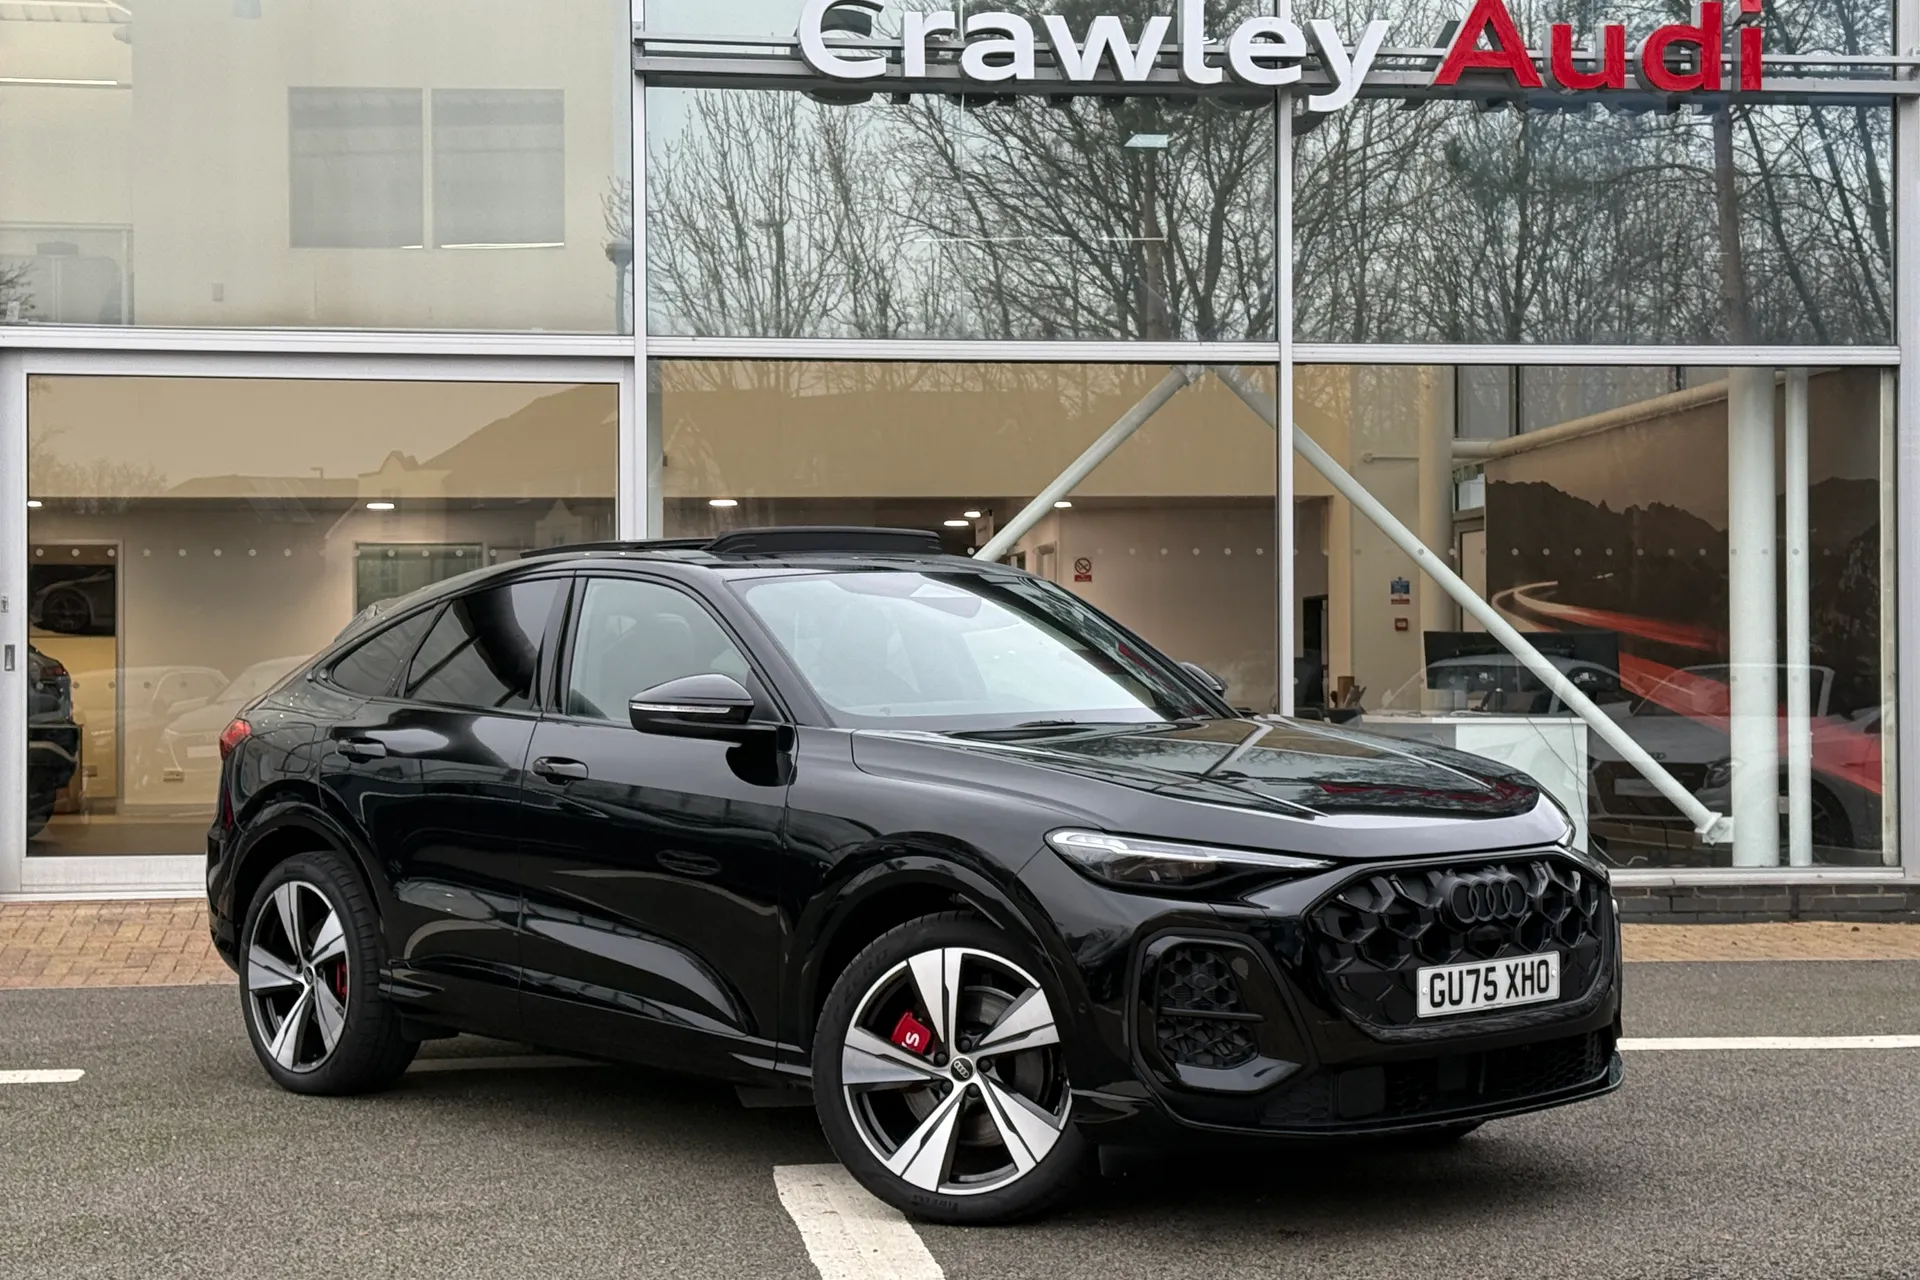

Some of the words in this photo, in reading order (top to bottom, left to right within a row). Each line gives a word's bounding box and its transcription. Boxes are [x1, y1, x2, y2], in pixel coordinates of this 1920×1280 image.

[796, 0, 1390, 111] Crawley
[1432, 0, 1763, 91] Audi
[1429, 966, 1498, 1008] GU75
[1505, 959, 1550, 999] XHO
[905, 1031, 920, 1047] S
